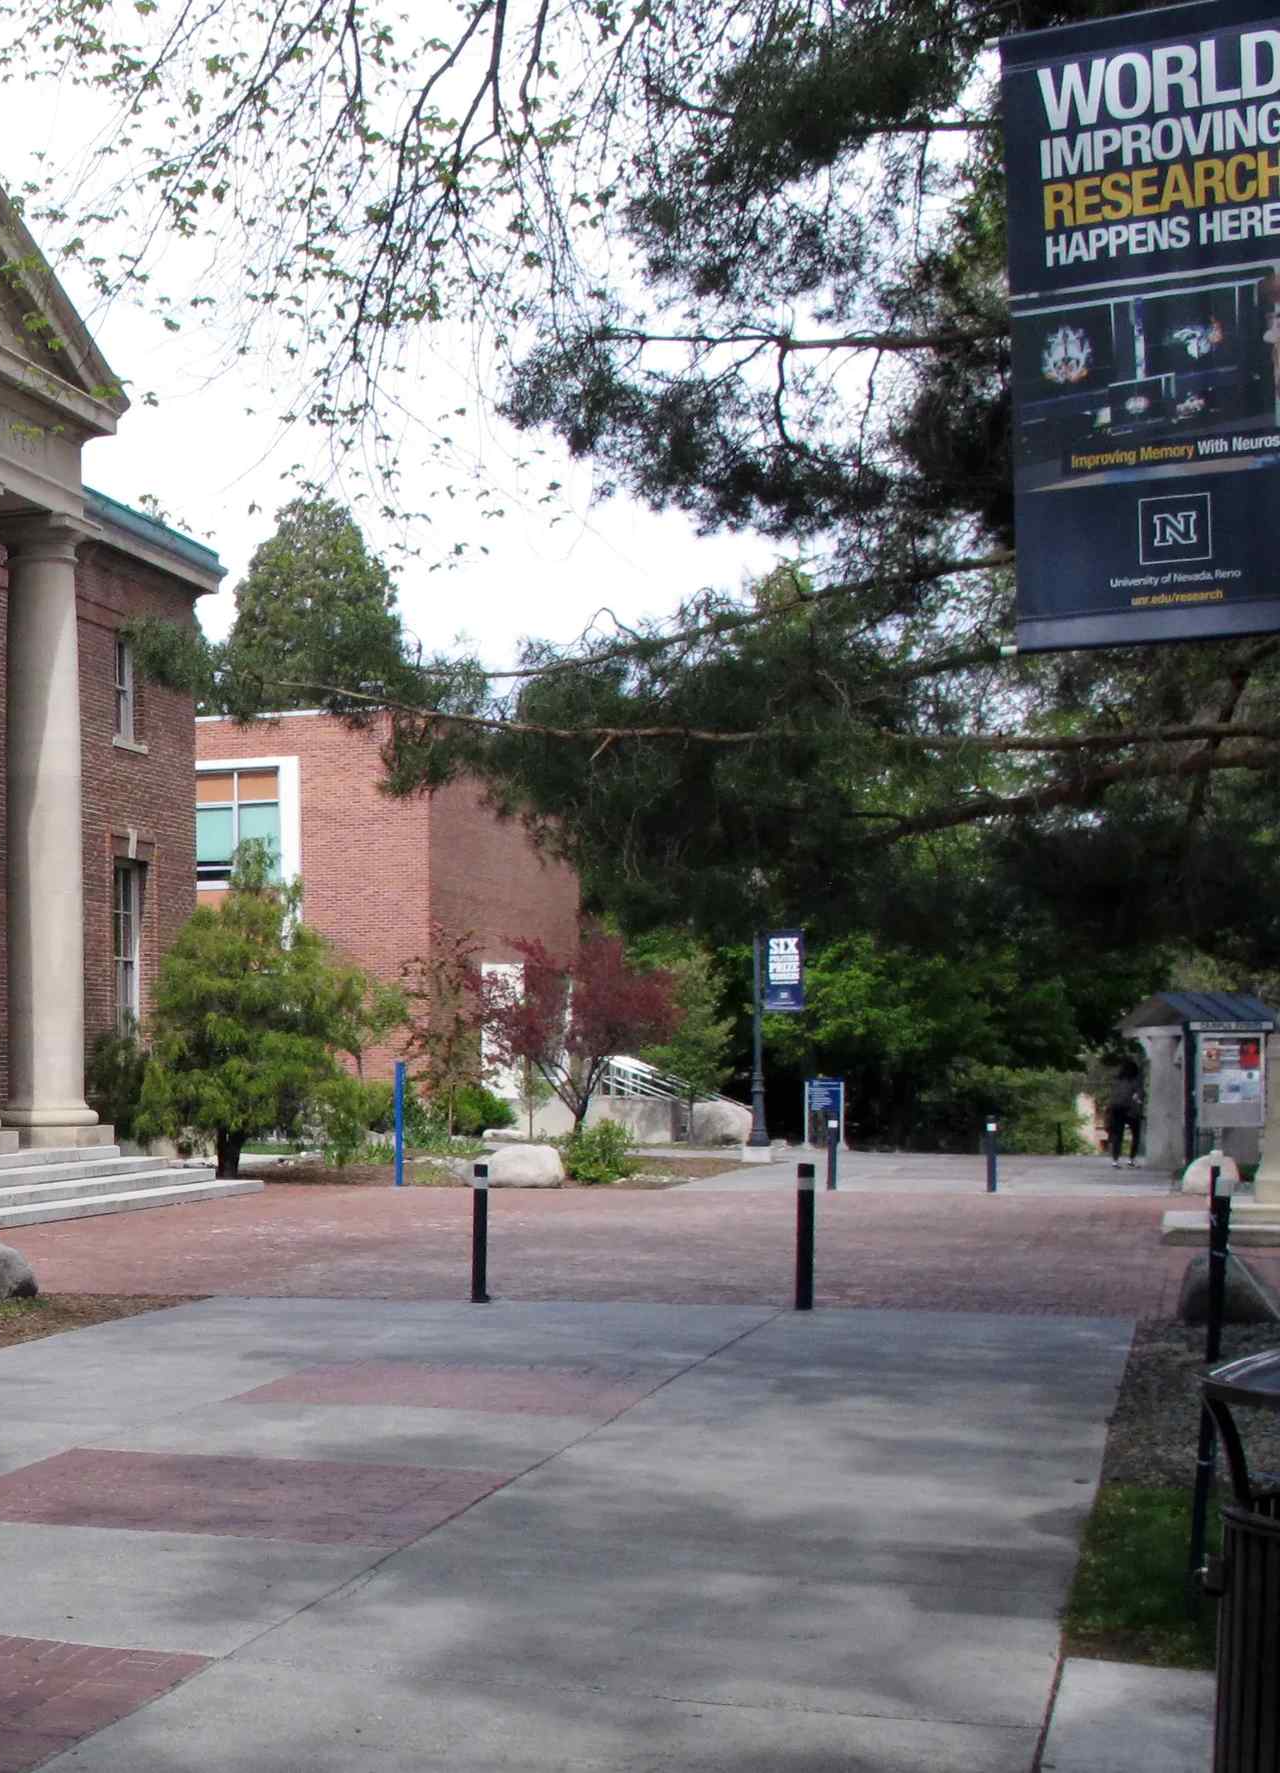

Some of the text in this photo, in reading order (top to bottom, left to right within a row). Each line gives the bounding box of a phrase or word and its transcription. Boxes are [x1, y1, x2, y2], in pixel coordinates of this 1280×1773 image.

[1037, 30, 1280, 131] WORLD
[1040, 102, 1280, 180] IMPROVING
[1043, 151, 1280, 231] RESEARCH
[1045, 202, 1280, 267] HAPPENS HERE
[1071, 449, 1136, 469] Improving
[1140, 442, 1194, 462] Memory
[1197, 436, 1229, 455] With
[1110, 575, 1160, 588] University
[1161, 573, 1173, 584] of
[1215, 569, 1242, 579] Reno
[769, 937, 800, 954] SIX
